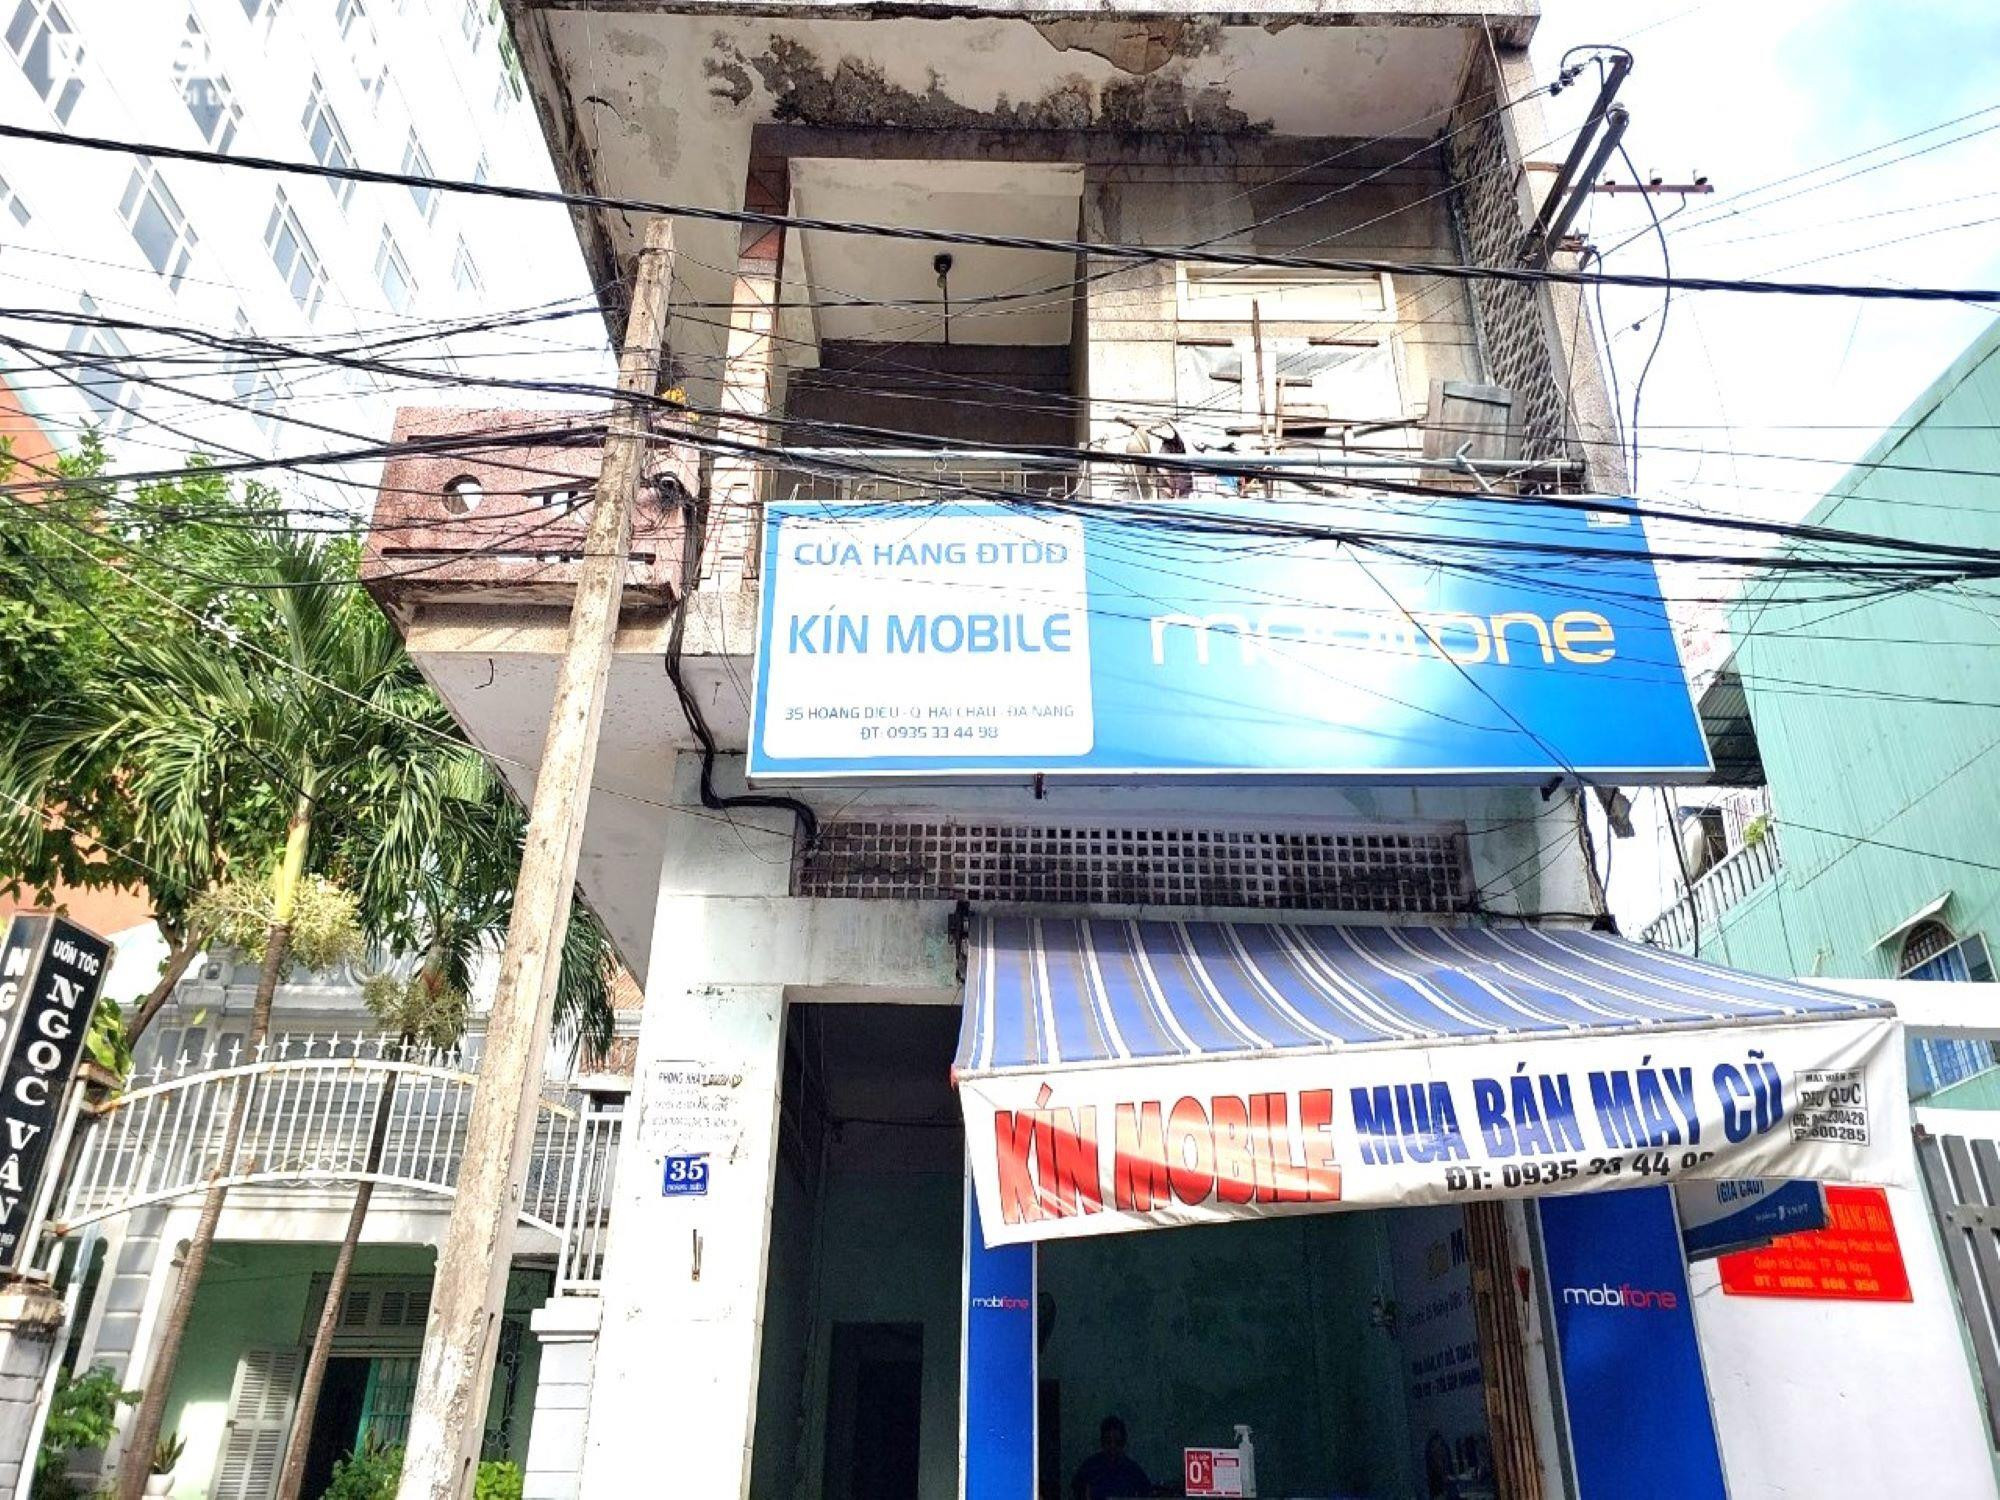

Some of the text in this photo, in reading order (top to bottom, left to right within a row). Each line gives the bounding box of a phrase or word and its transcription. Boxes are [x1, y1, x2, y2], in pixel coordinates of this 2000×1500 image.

[788, 604, 1072, 654] KÍN MOBILE
[1151, 611, 1618, 666] mofone
[785, 706, 804, 720] 35
[886, 726, 928, 739] 0935
[931, 726, 950, 739] 33
[953, 726, 974, 739] 44
[978, 726, 999, 739] 98
[14, 972, 85, 1106] NGỌC
[994, 1049, 1785, 1226] KÍN MOBILE MUA BÁN MÁY CŨ
[669, 1159, 704, 1182] 35
[1444, 1165, 1493, 1192] ĐT:
[1501, 1158, 1579, 1189] 0935
[1631, 1152, 1671, 1176] 44
[971, 1295, 1030, 1310] mobifone
[1563, 1282, 1680, 1310] mobifone
